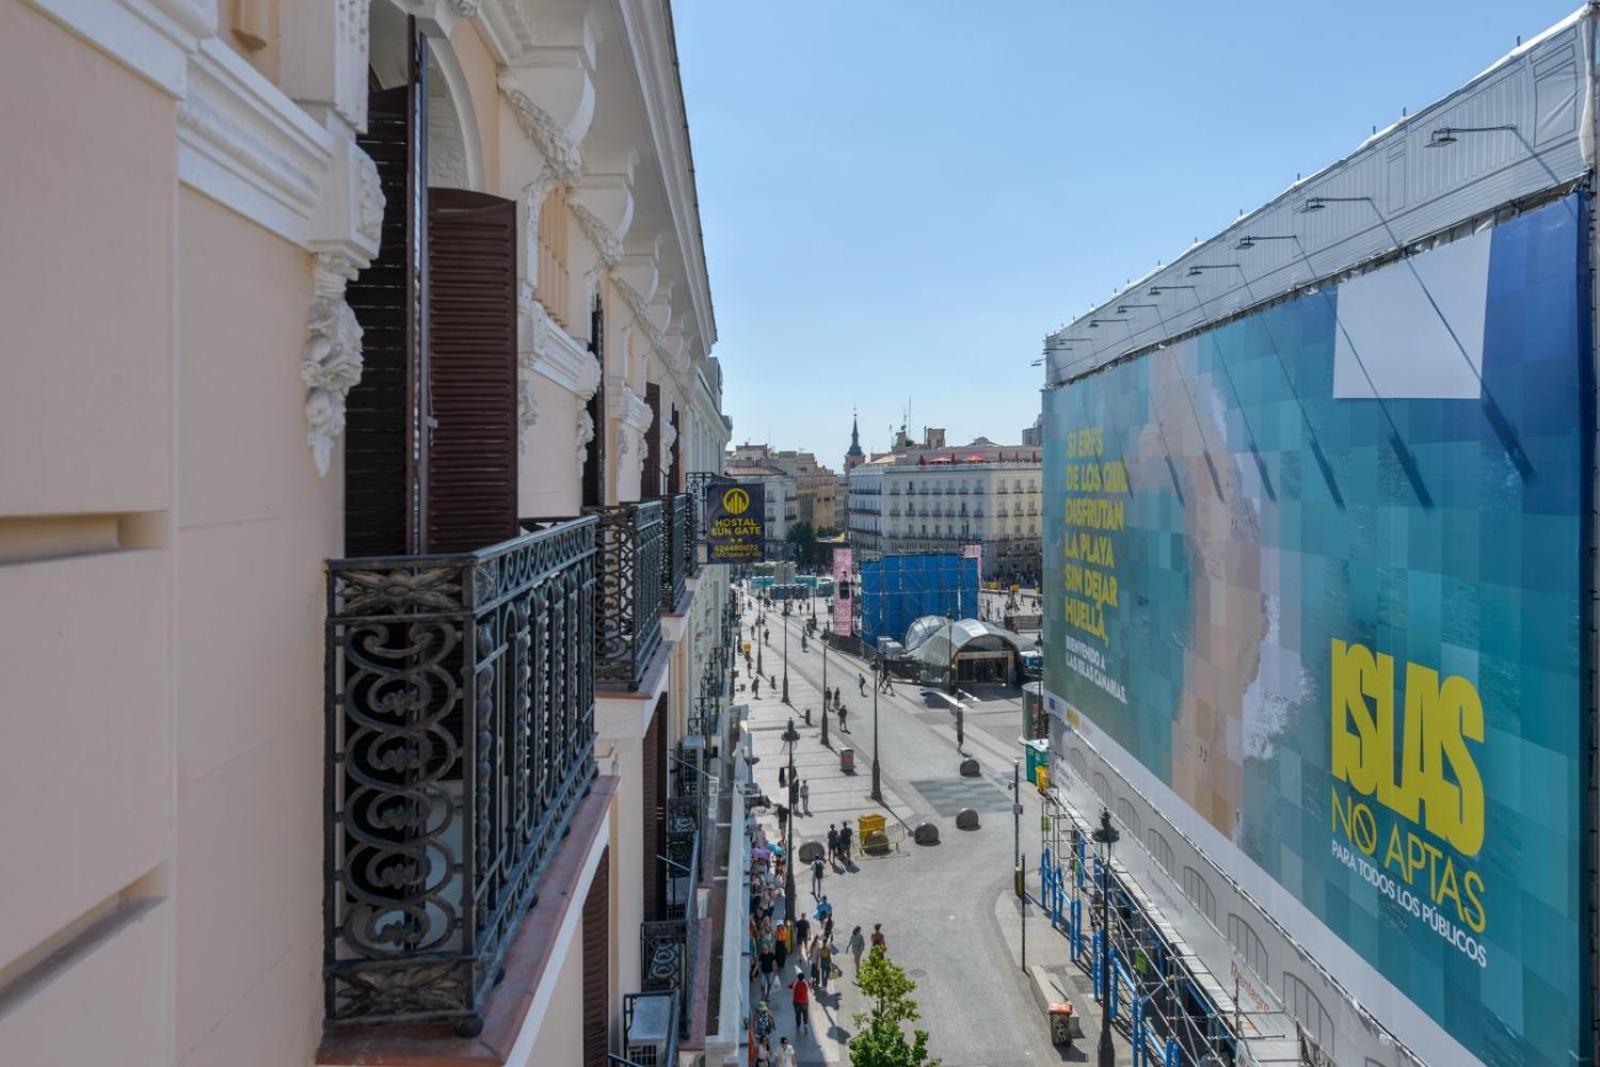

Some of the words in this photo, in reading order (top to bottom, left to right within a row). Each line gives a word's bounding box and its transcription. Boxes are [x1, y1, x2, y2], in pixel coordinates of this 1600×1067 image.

[1065, 464, 1080, 492] DE
[1082, 462, 1101, 492] LOS
[711, 527, 732, 537] SUN
[734, 526, 761, 536] GATE
[715, 518, 756, 527] HOSTAL
[1065, 497, 1124, 532] DISFRUTAN
[1064, 531, 1079, 559] LA
[1080, 533, 1115, 568] PLAYA
[1065, 564, 1082, 593] SIN
[1084, 568, 1118, 609] DEJAR
[1101, 655, 1106, 671] A
[1331, 637, 1485, 857] ISLAS
[1332, 784, 1377, 855] NO
[1384, 822, 1486, 933] APTAS
[1332, 839, 1357, 874] PARA
[1358, 858, 1396, 900] TODOS
[1397, 886, 1421, 920] LOS
[1422, 906, 1487, 968] PÚBLICOS
